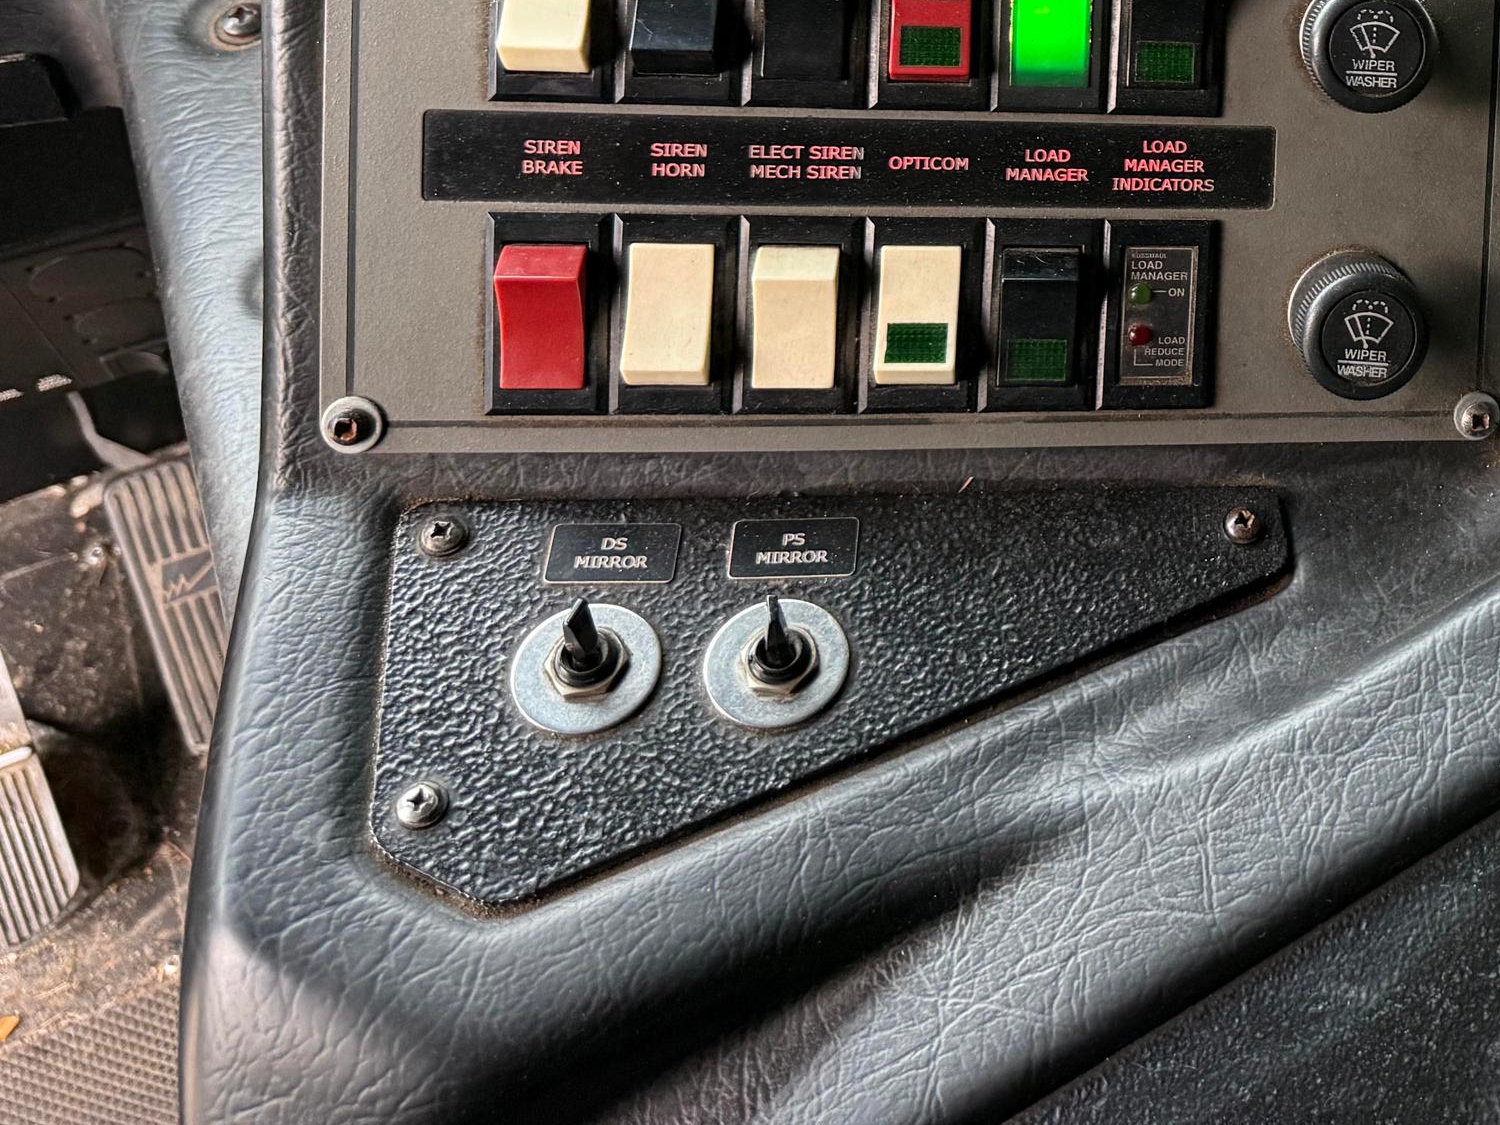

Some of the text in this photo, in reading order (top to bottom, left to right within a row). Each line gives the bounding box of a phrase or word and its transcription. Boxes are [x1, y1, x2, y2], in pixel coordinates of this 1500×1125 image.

[1351, 58, 1395, 72] WIPER
[1345, 75, 1397, 88] WASHER
[523, 139, 581, 156] SIREN
[650, 142, 707, 159] SIREN
[748, 145, 864, 161] ELECT SIREN
[1142, 140, 1188, 155] LOAD
[888, 155, 969, 171] OPTICOM
[1024, 148, 1071, 164] LOAD
[521, 160, 583, 176] BRAKE
[651, 162, 705, 178] HORN
[749, 164, 862, 180] MECH SIREN
[1124, 158, 1205, 174] MANAGER
[1005, 167, 1088, 183] MANAGER
[1112, 177, 1215, 193] INDICATORS
[1131, 260, 1163, 270] LOAD
[1130, 271, 1188, 281] MANAGER
[1168, 288, 1185, 297] ON
[1158, 336, 1185, 345] LOAD
[1144, 347, 1185, 356] REDUCE
[1344, 348, 1387, 361] WIPER
[1155, 358, 1184, 367] MODE
[1337, 364, 1387, 378] WASHER
[600, 536, 628, 551] DS
[781, 532, 806, 547] PS
[573, 555, 649, 569] MIRROR
[755, 550, 829, 565] MIRROR
